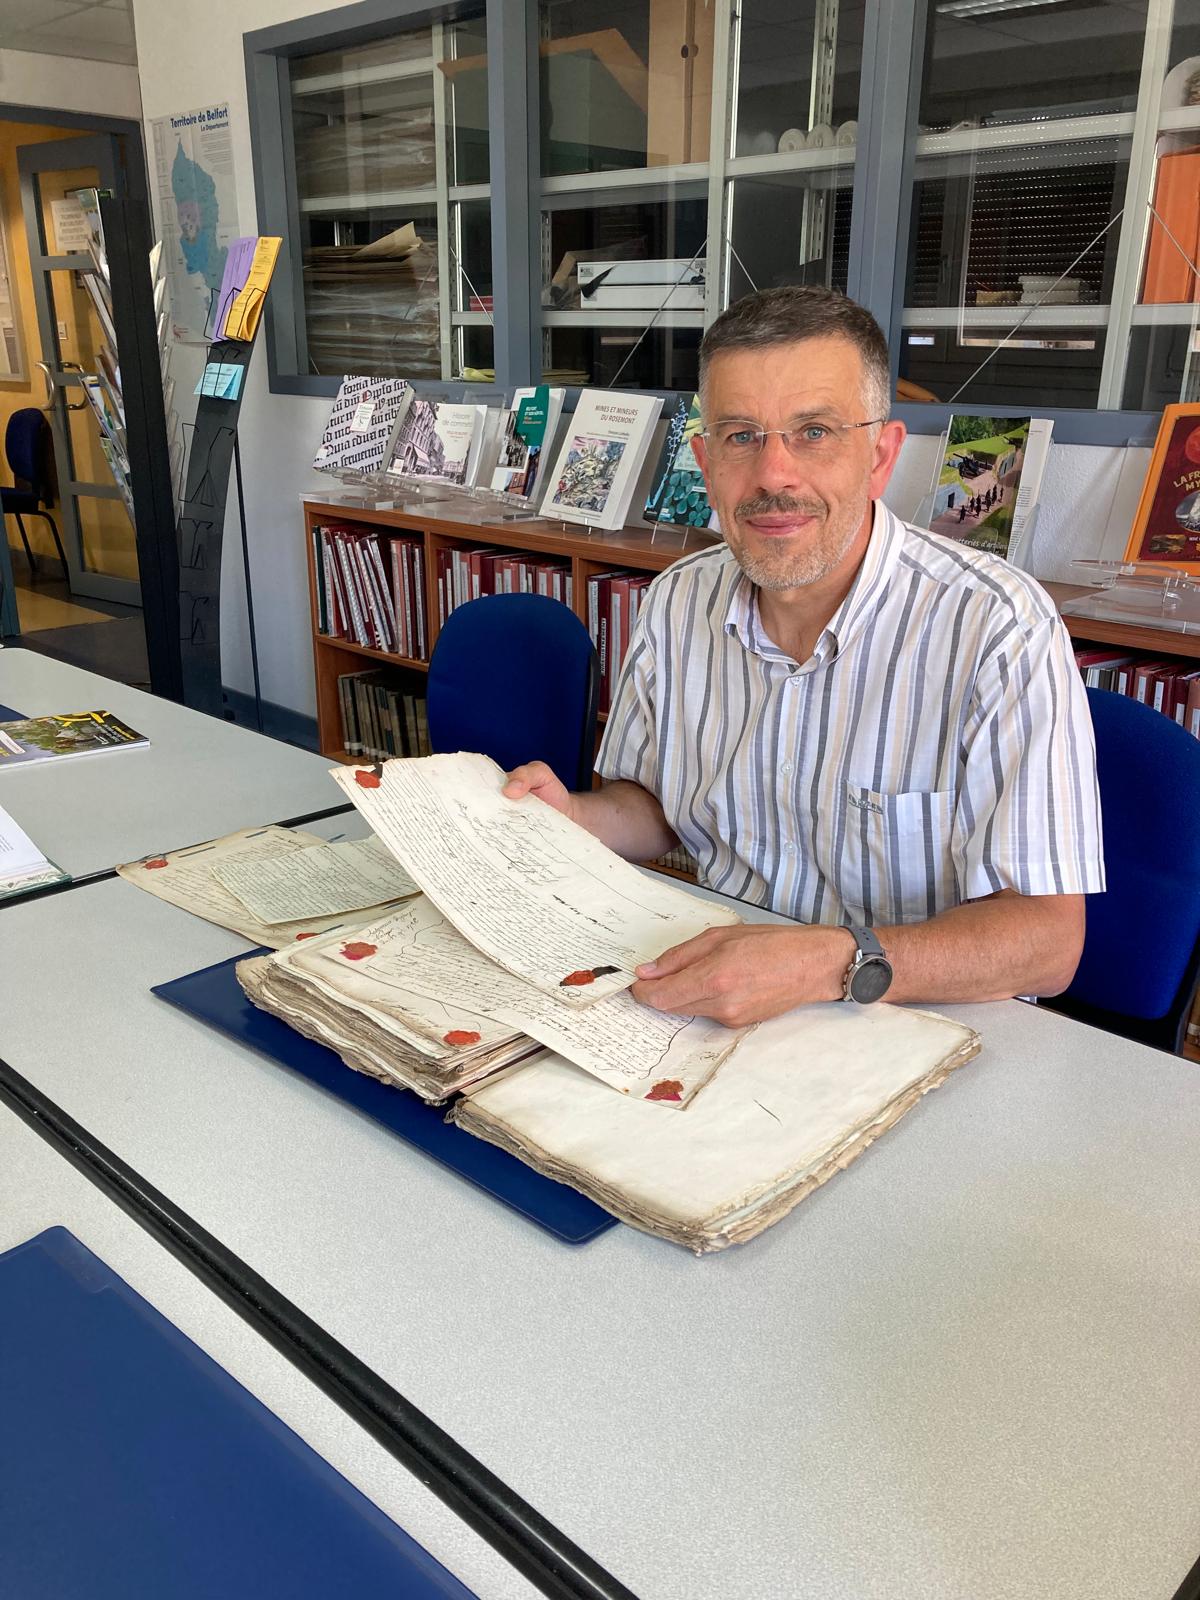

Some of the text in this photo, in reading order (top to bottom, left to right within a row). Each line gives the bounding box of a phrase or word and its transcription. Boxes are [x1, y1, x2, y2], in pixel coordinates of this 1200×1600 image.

[170, 107, 228, 128] Territoire de Belfort
[595, 405, 609, 413] MINES
[617, 407, 639, 416] MINEURS
[609, 415, 635, 424] ROSEMONT
[1173, 475, 1188, 488] LA
